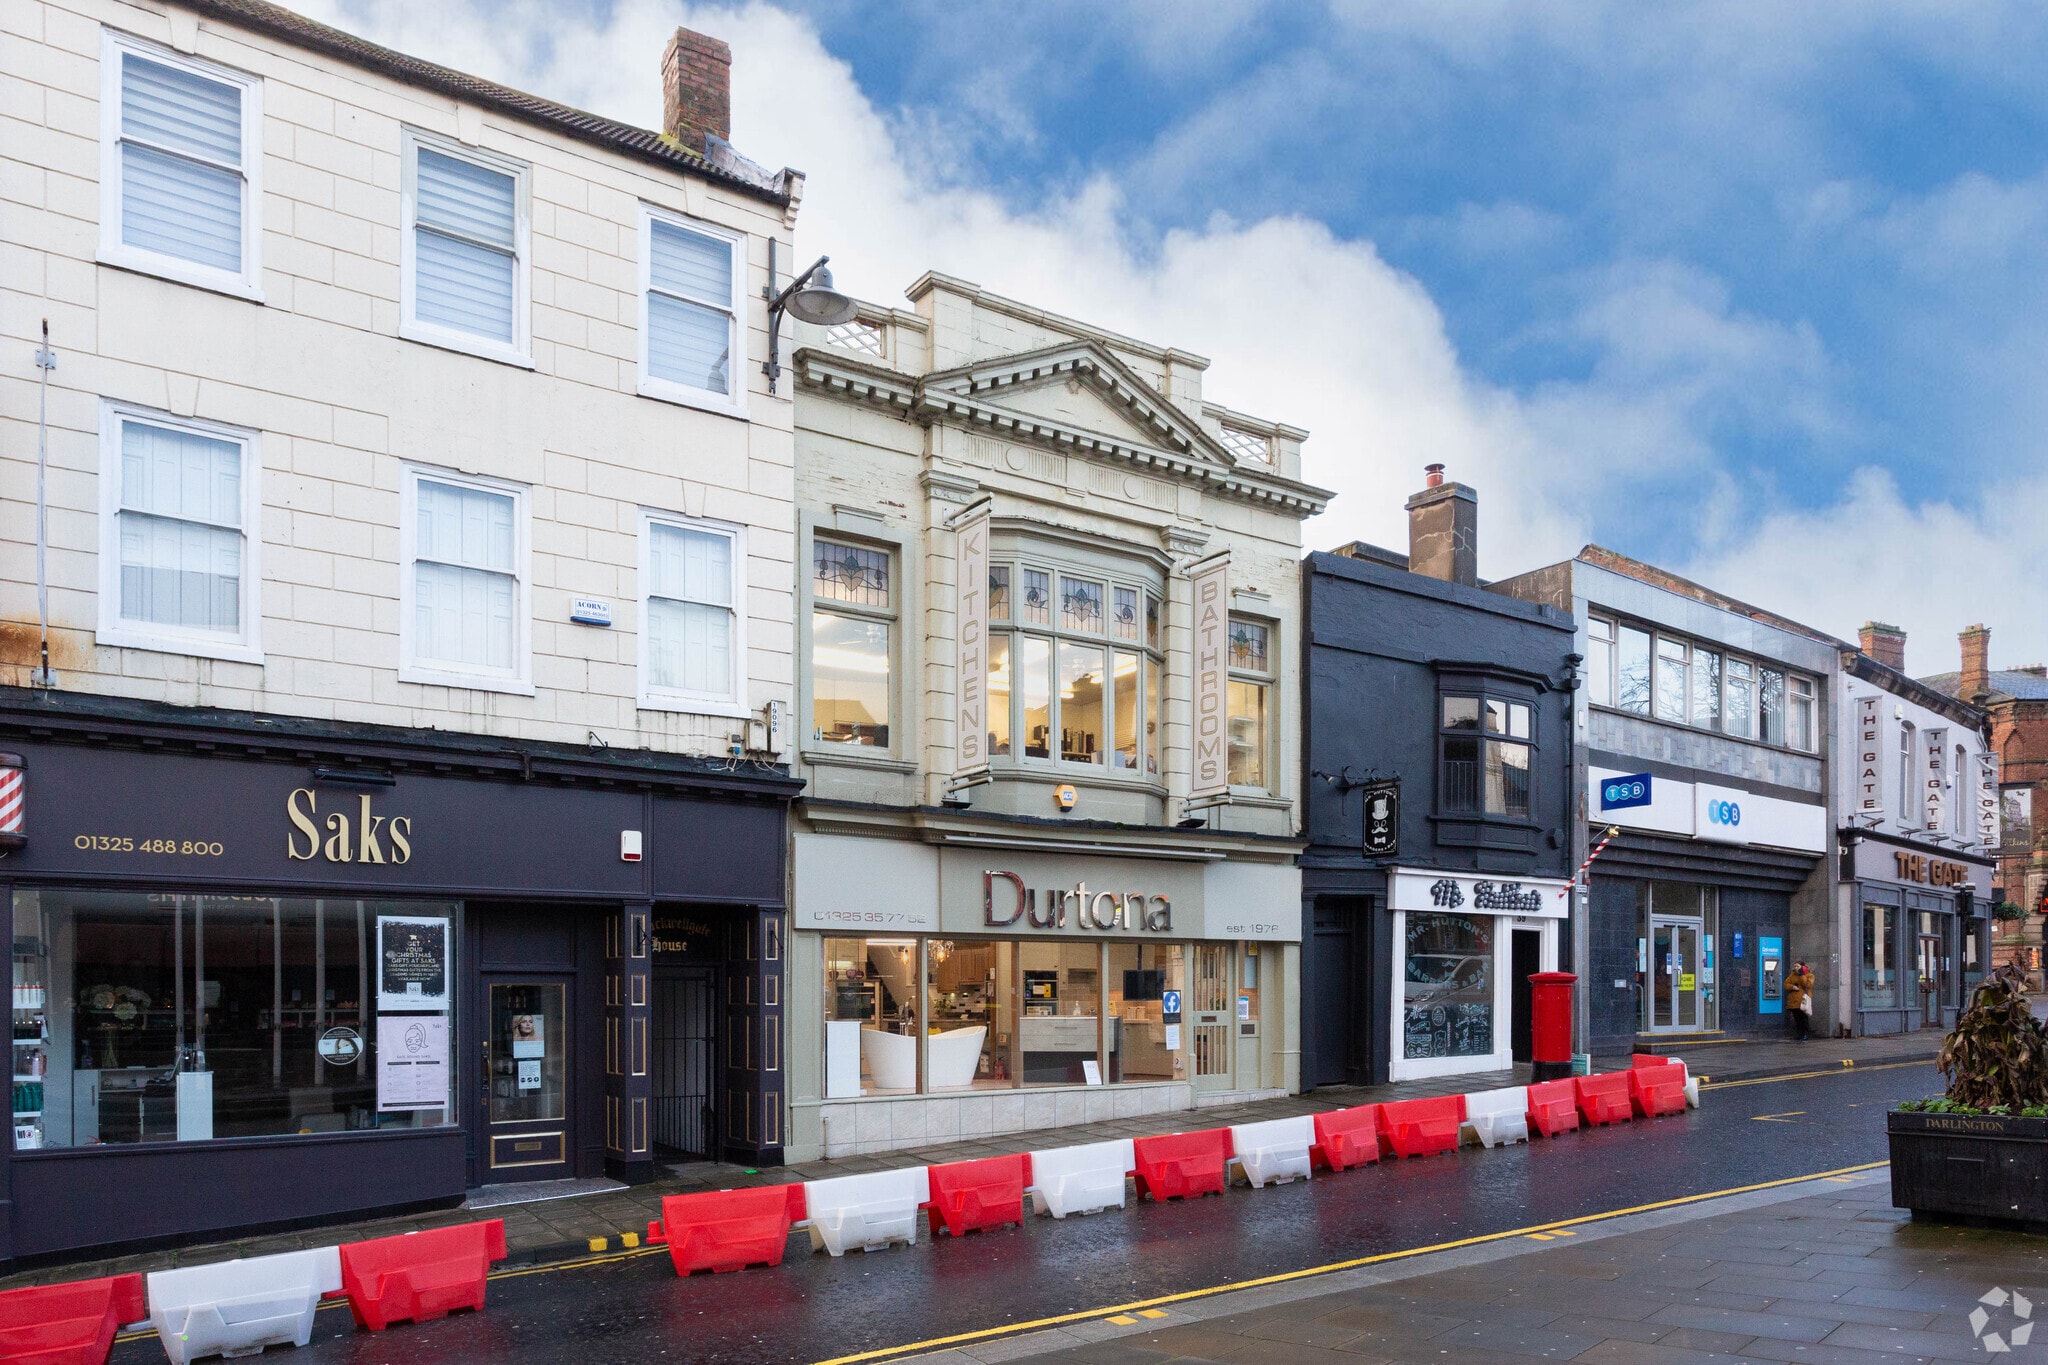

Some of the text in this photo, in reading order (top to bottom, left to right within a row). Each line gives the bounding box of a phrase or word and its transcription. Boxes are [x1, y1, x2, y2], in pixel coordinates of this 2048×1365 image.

[577, 601, 601, 610] ACORN
[962, 531, 982, 759] KITCHENS
[1198, 580, 1220, 781] BATHROOMS
[1863, 701, 1875, 808] THE GATE
[1607, 784, 1642, 799] TSB
[1927, 732, 1941, 830] THE GATE
[1982, 757, 1994, 845] THE GATE
[287, 788, 411, 865] Saks
[74, 835, 223, 856] 01325 488 800
[1894, 851, 1968, 888] THE GATE
[814, 911, 861, 922] 01325
[864, 912, 884, 922] 35
[886, 913, 905, 922] 77
[984, 870, 1174, 931] Durtona
[1226, 924, 1279, 934] est 1976
[1407, 925, 1429, 942] MR.
[1926, 1118, 2004, 1131] DARLINGTON
